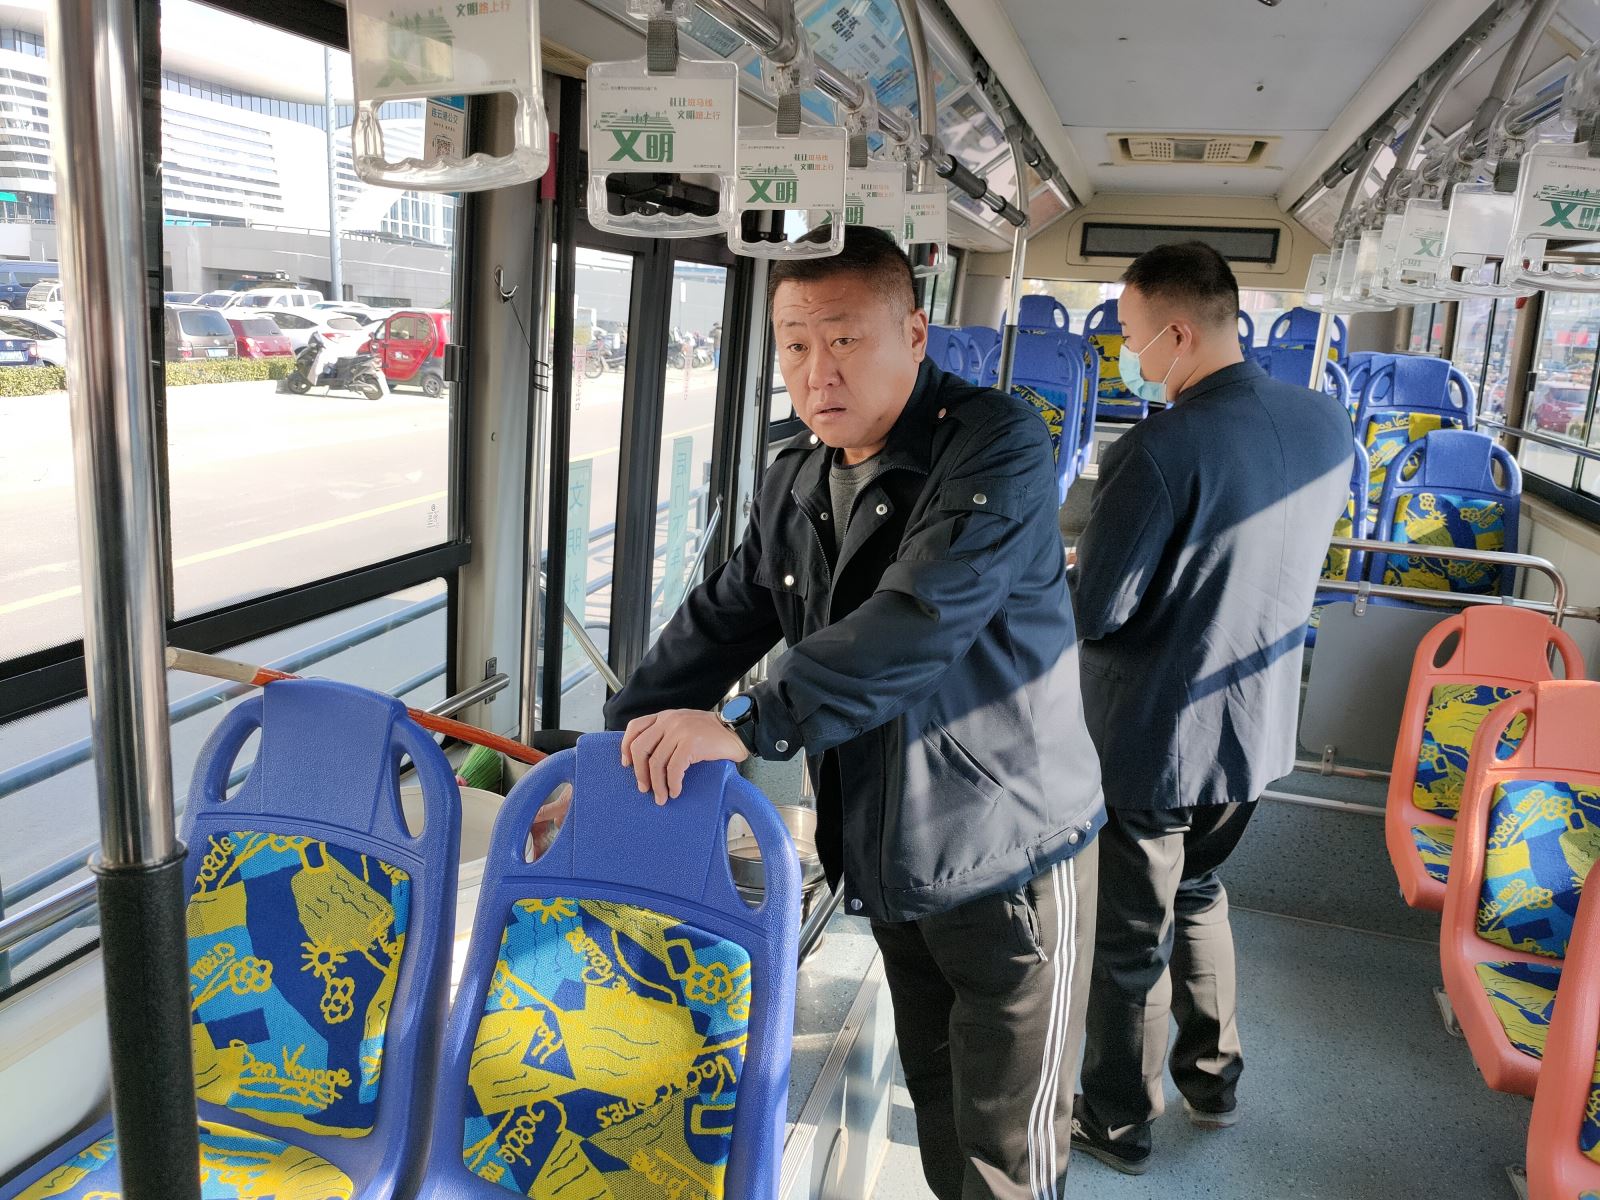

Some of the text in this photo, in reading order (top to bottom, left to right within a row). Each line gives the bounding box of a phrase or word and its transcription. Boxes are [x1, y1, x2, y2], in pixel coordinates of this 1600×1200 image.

[456, 2, 511, 17] 文明路上行
[677, 110, 721, 120] 文明路上行
[607, 129, 674, 162] 文明
[745, 179, 798, 204] 文明
